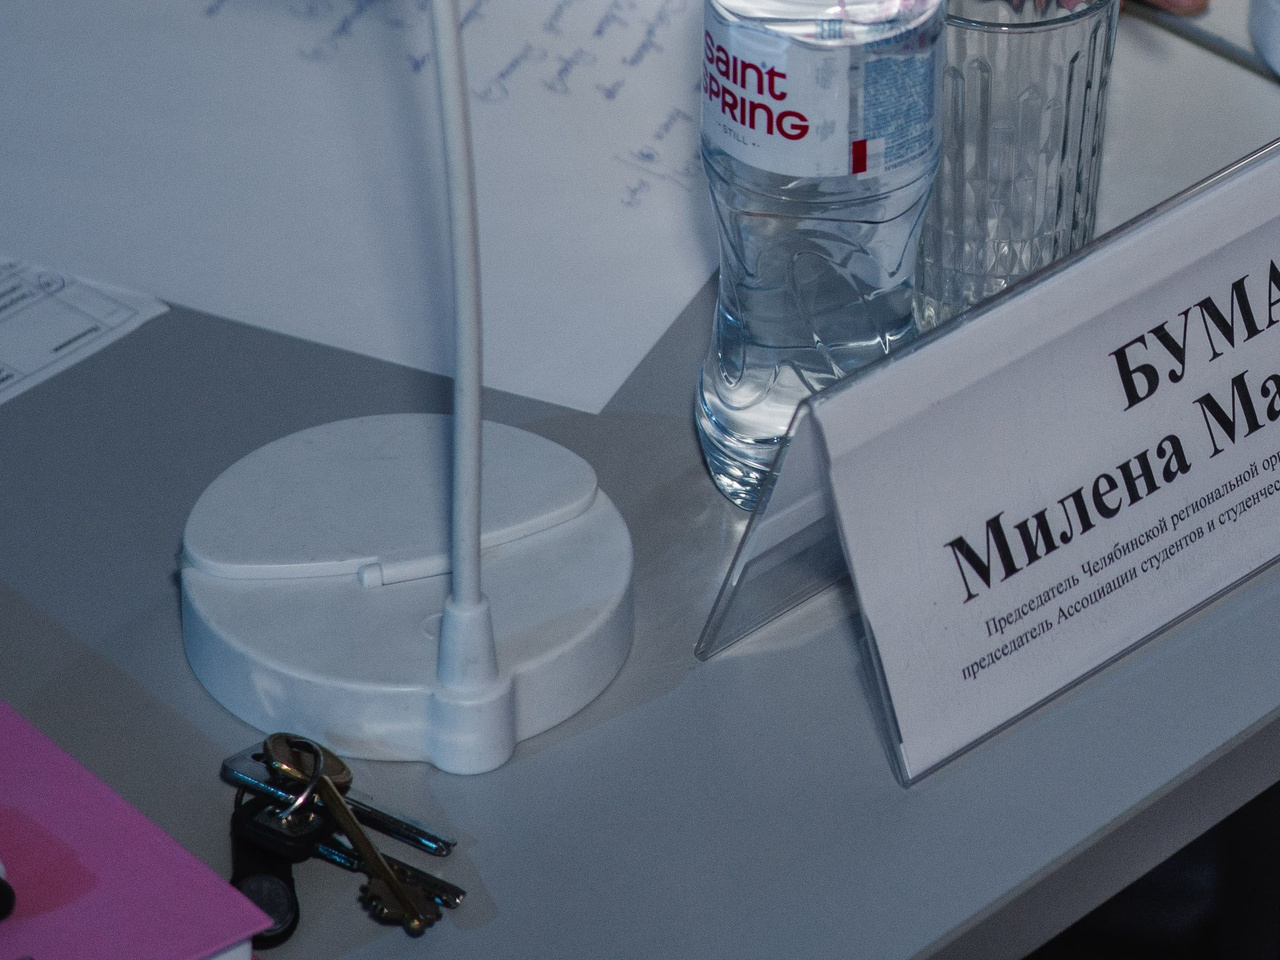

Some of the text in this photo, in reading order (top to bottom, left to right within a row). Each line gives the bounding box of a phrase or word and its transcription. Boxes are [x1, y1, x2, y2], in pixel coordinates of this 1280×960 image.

[722, 124, 748, 146] STILL
[945, 434, 1192, 603] Милена
[961, 619, 1054, 681] председатель
[1057, 566, 1139, 625] Ассоциации
[1140, 526, 1206, 574] студентов
[1206, 519, 1216, 533] и
[984, 574, 1080, 638] Председатель
[1080, 517, 1169, 578] Челябинской
[1169, 461, 1260, 532] региональной
